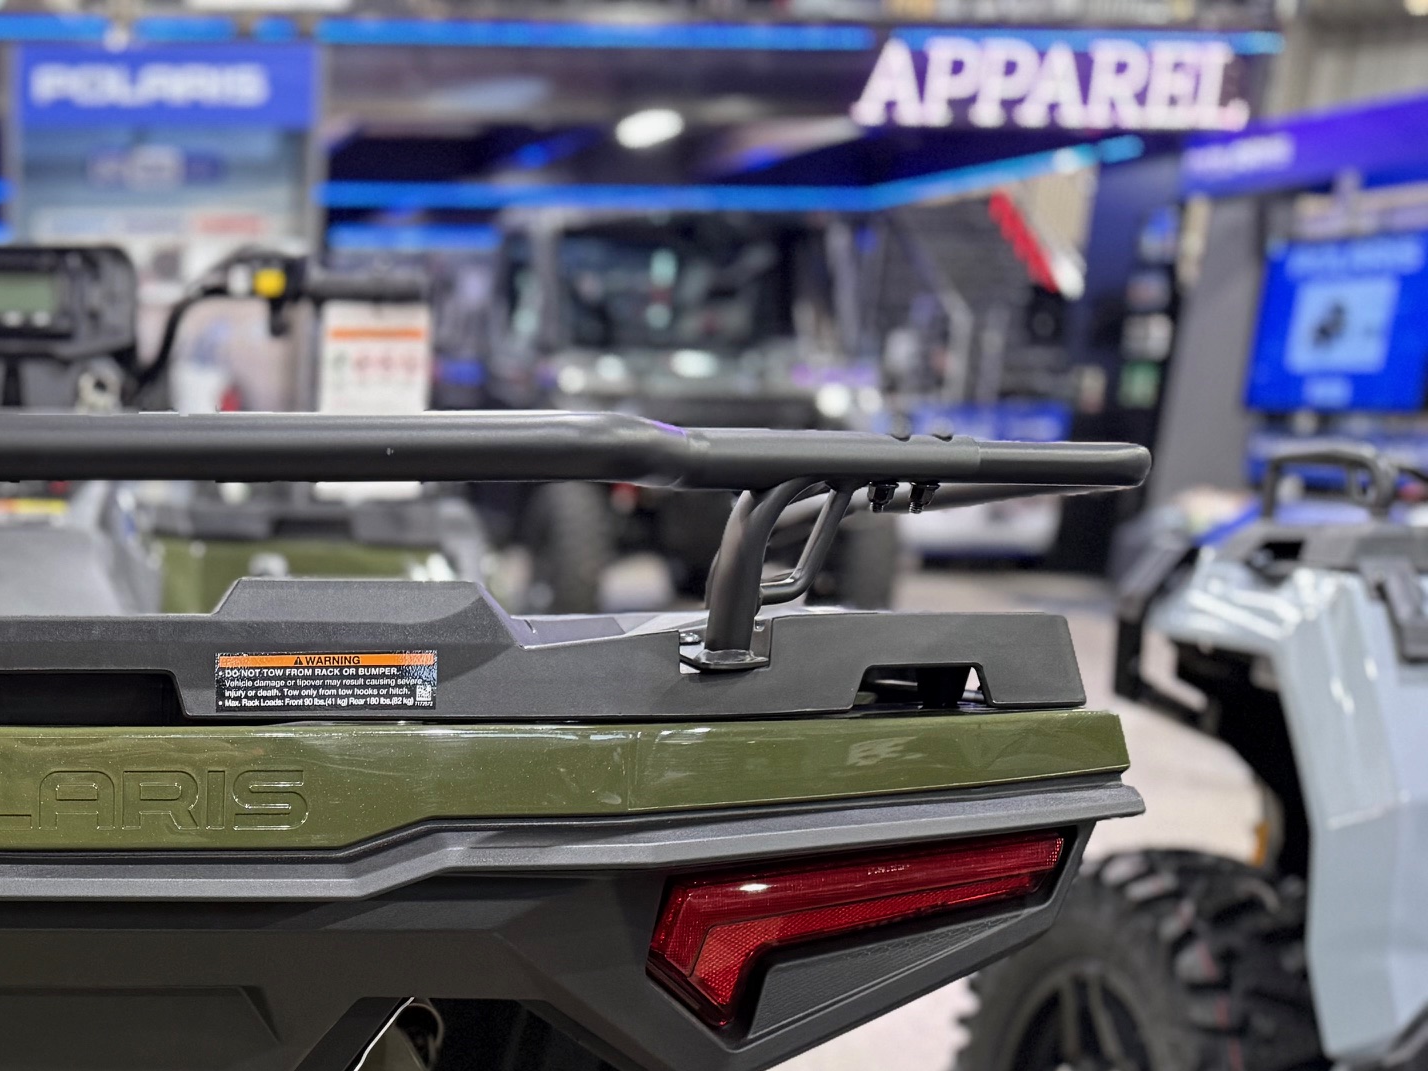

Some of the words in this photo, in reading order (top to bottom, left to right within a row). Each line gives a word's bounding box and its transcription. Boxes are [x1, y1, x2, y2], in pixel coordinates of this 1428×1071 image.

[29, 62, 270, 108] POLARIS
[850, 36, 1250, 131] APPAREL
[305, 656, 361, 665] WARNING
[225, 669, 240, 677] DO
[241, 669, 260, 677] NOT
[286, 668, 312, 676] FROM
[315, 668, 340, 676] RACK
[225, 679, 253, 687] Vehicle
[254, 679, 285, 687] damage
[297, 679, 323, 687] tipover
[325, 679, 340, 687] may
[366, 678, 395, 686] causing
[283, 688, 299, 696] Tow
[301, 688, 317, 697] only
[319, 687, 336, 695] from
[338, 687, 352, 695] tow
[225, 699, 241, 707] Max.
[349, 697, 365, 705] Rear
